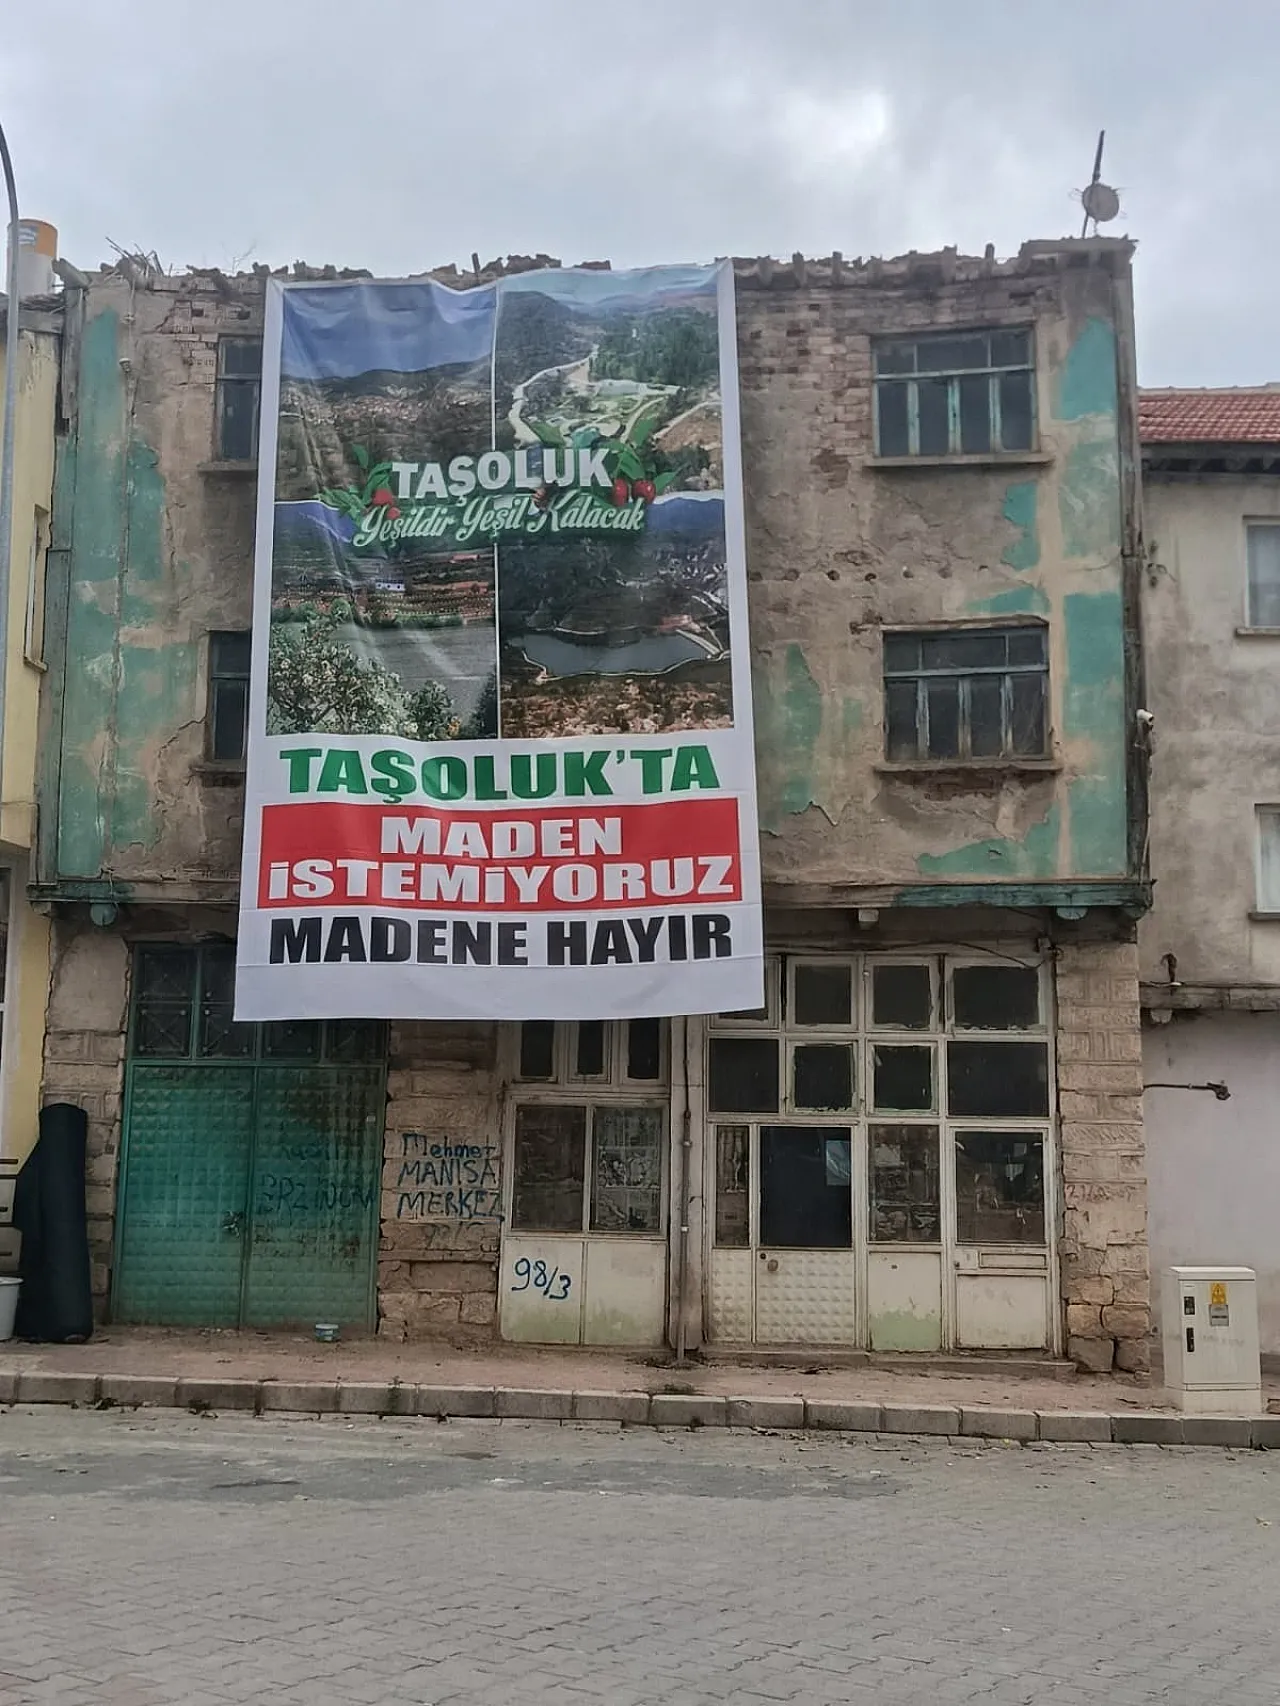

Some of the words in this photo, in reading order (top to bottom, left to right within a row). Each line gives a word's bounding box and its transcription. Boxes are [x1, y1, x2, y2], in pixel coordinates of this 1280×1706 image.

[391, 448, 613, 506] TAŞOLUK
[353, 503, 454, 547] Yeşildir
[455, 494, 531, 542] Yeşil
[526, 488, 645, 533] Kalacak
[380, 816, 622, 859] MADEN
[269, 915, 528, 966] MADENE
[546, 913, 733, 965] HAYIR
[397, 1187, 505, 1223] MERKEZ
[511, 1257, 572, 1299] 98/3
